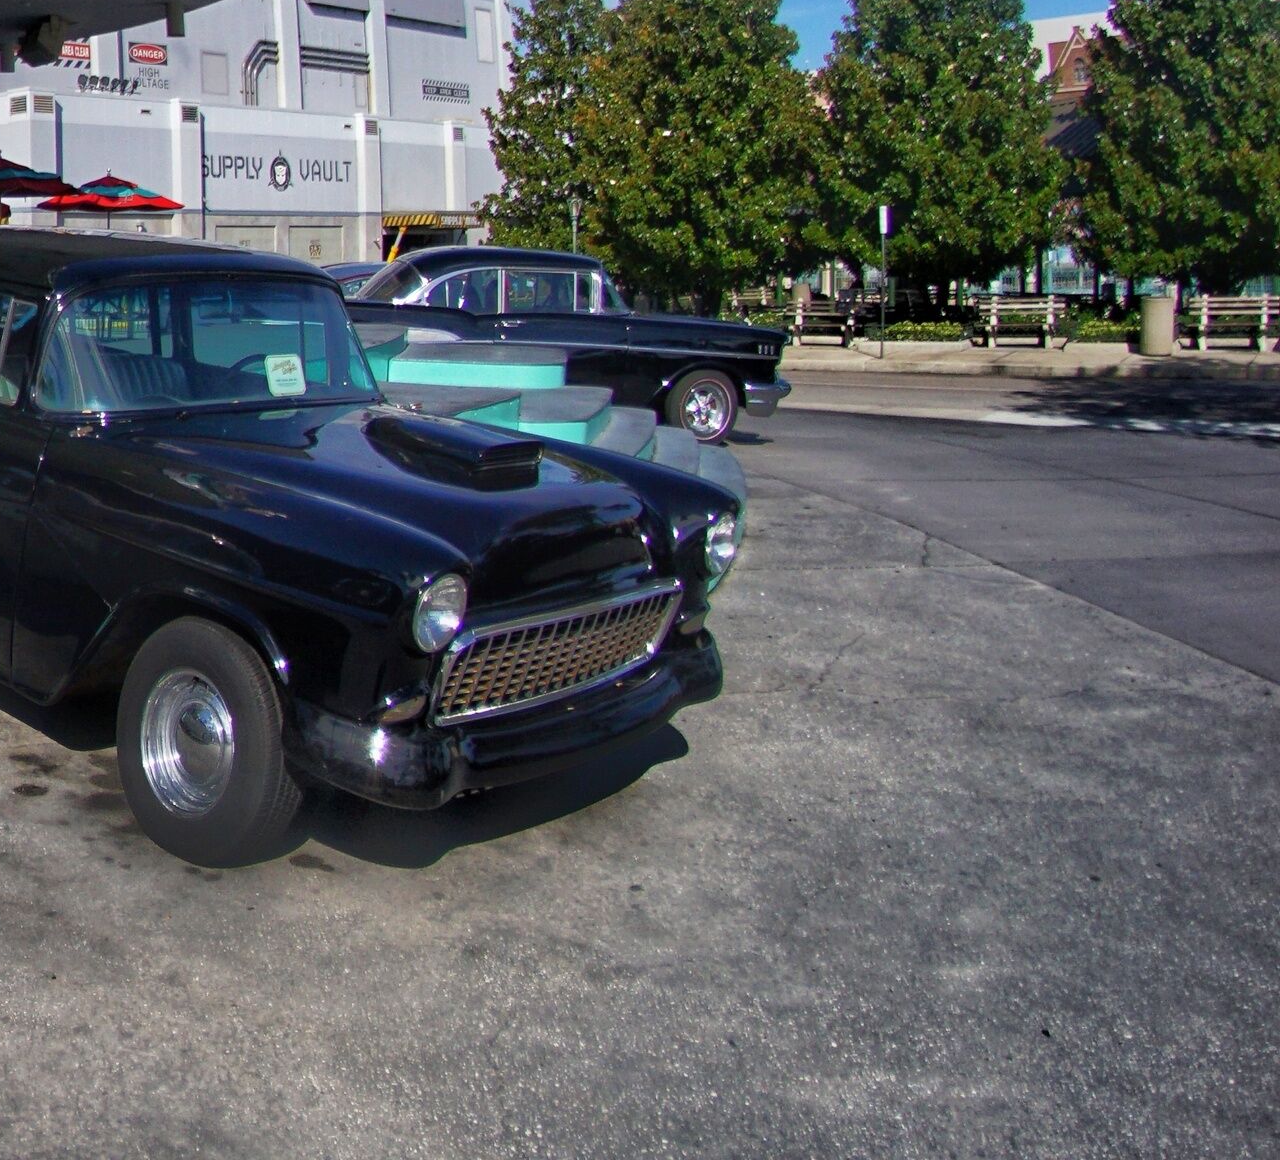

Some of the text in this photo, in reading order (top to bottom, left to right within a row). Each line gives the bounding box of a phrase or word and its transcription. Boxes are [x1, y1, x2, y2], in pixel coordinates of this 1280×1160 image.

[75, 45, 90, 58] CLEAR
[132, 48, 165, 60] DANGER
[138, 67, 160, 77] HIGH
[202, 154, 352, 183] SUPPLY VAULT
